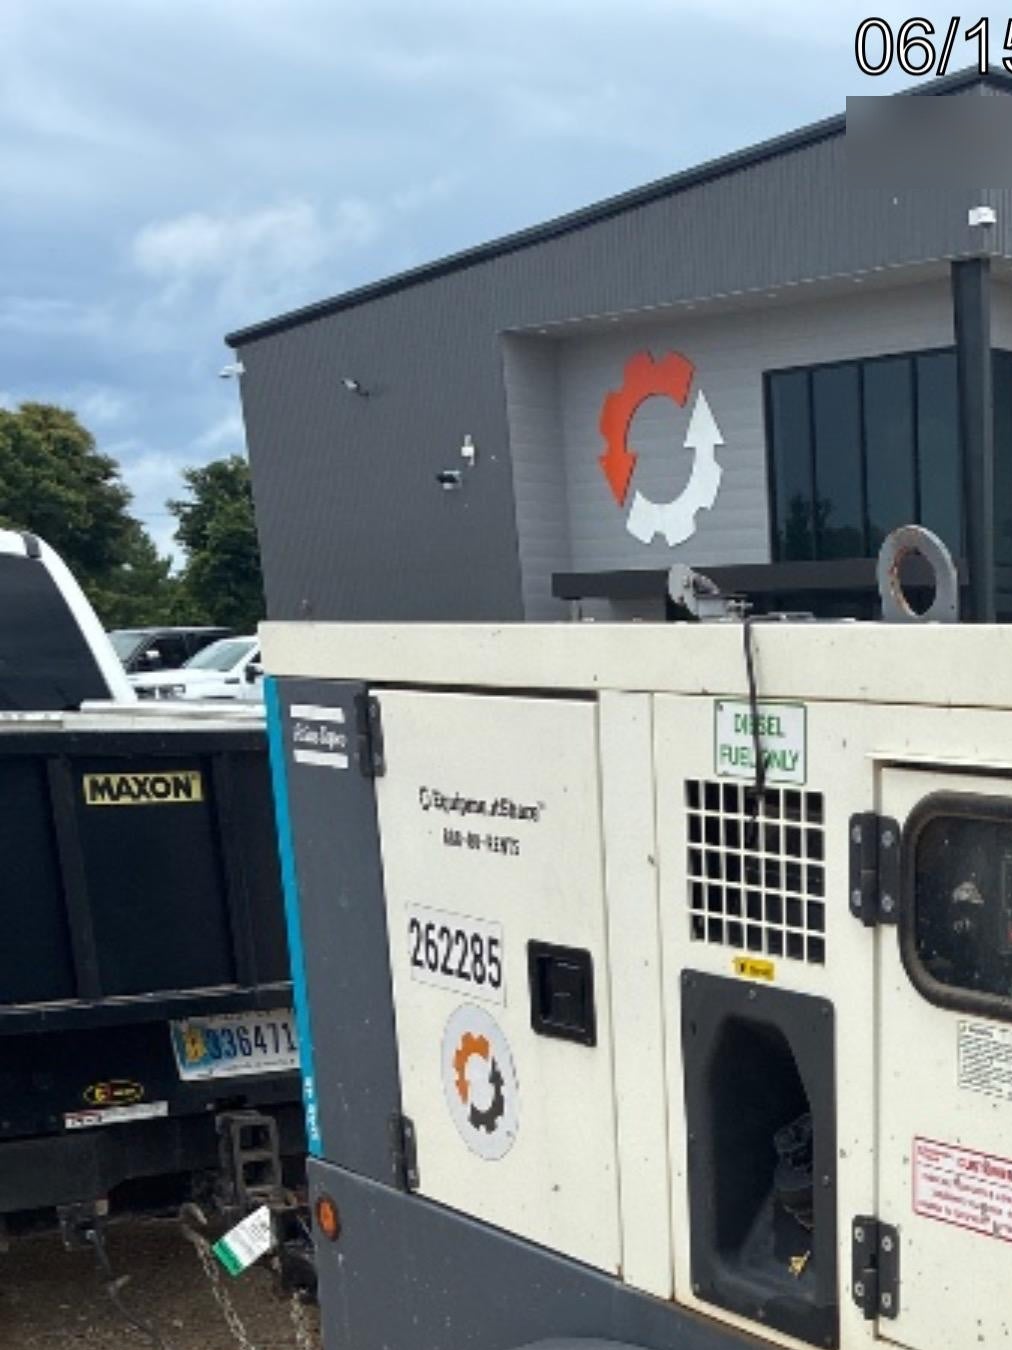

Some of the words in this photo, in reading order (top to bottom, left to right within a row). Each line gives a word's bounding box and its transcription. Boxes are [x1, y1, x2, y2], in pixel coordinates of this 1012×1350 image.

[734, 713, 785, 738] DISEL
[88, 775, 193, 802] MAXON
[409, 917, 502, 989] 262285
